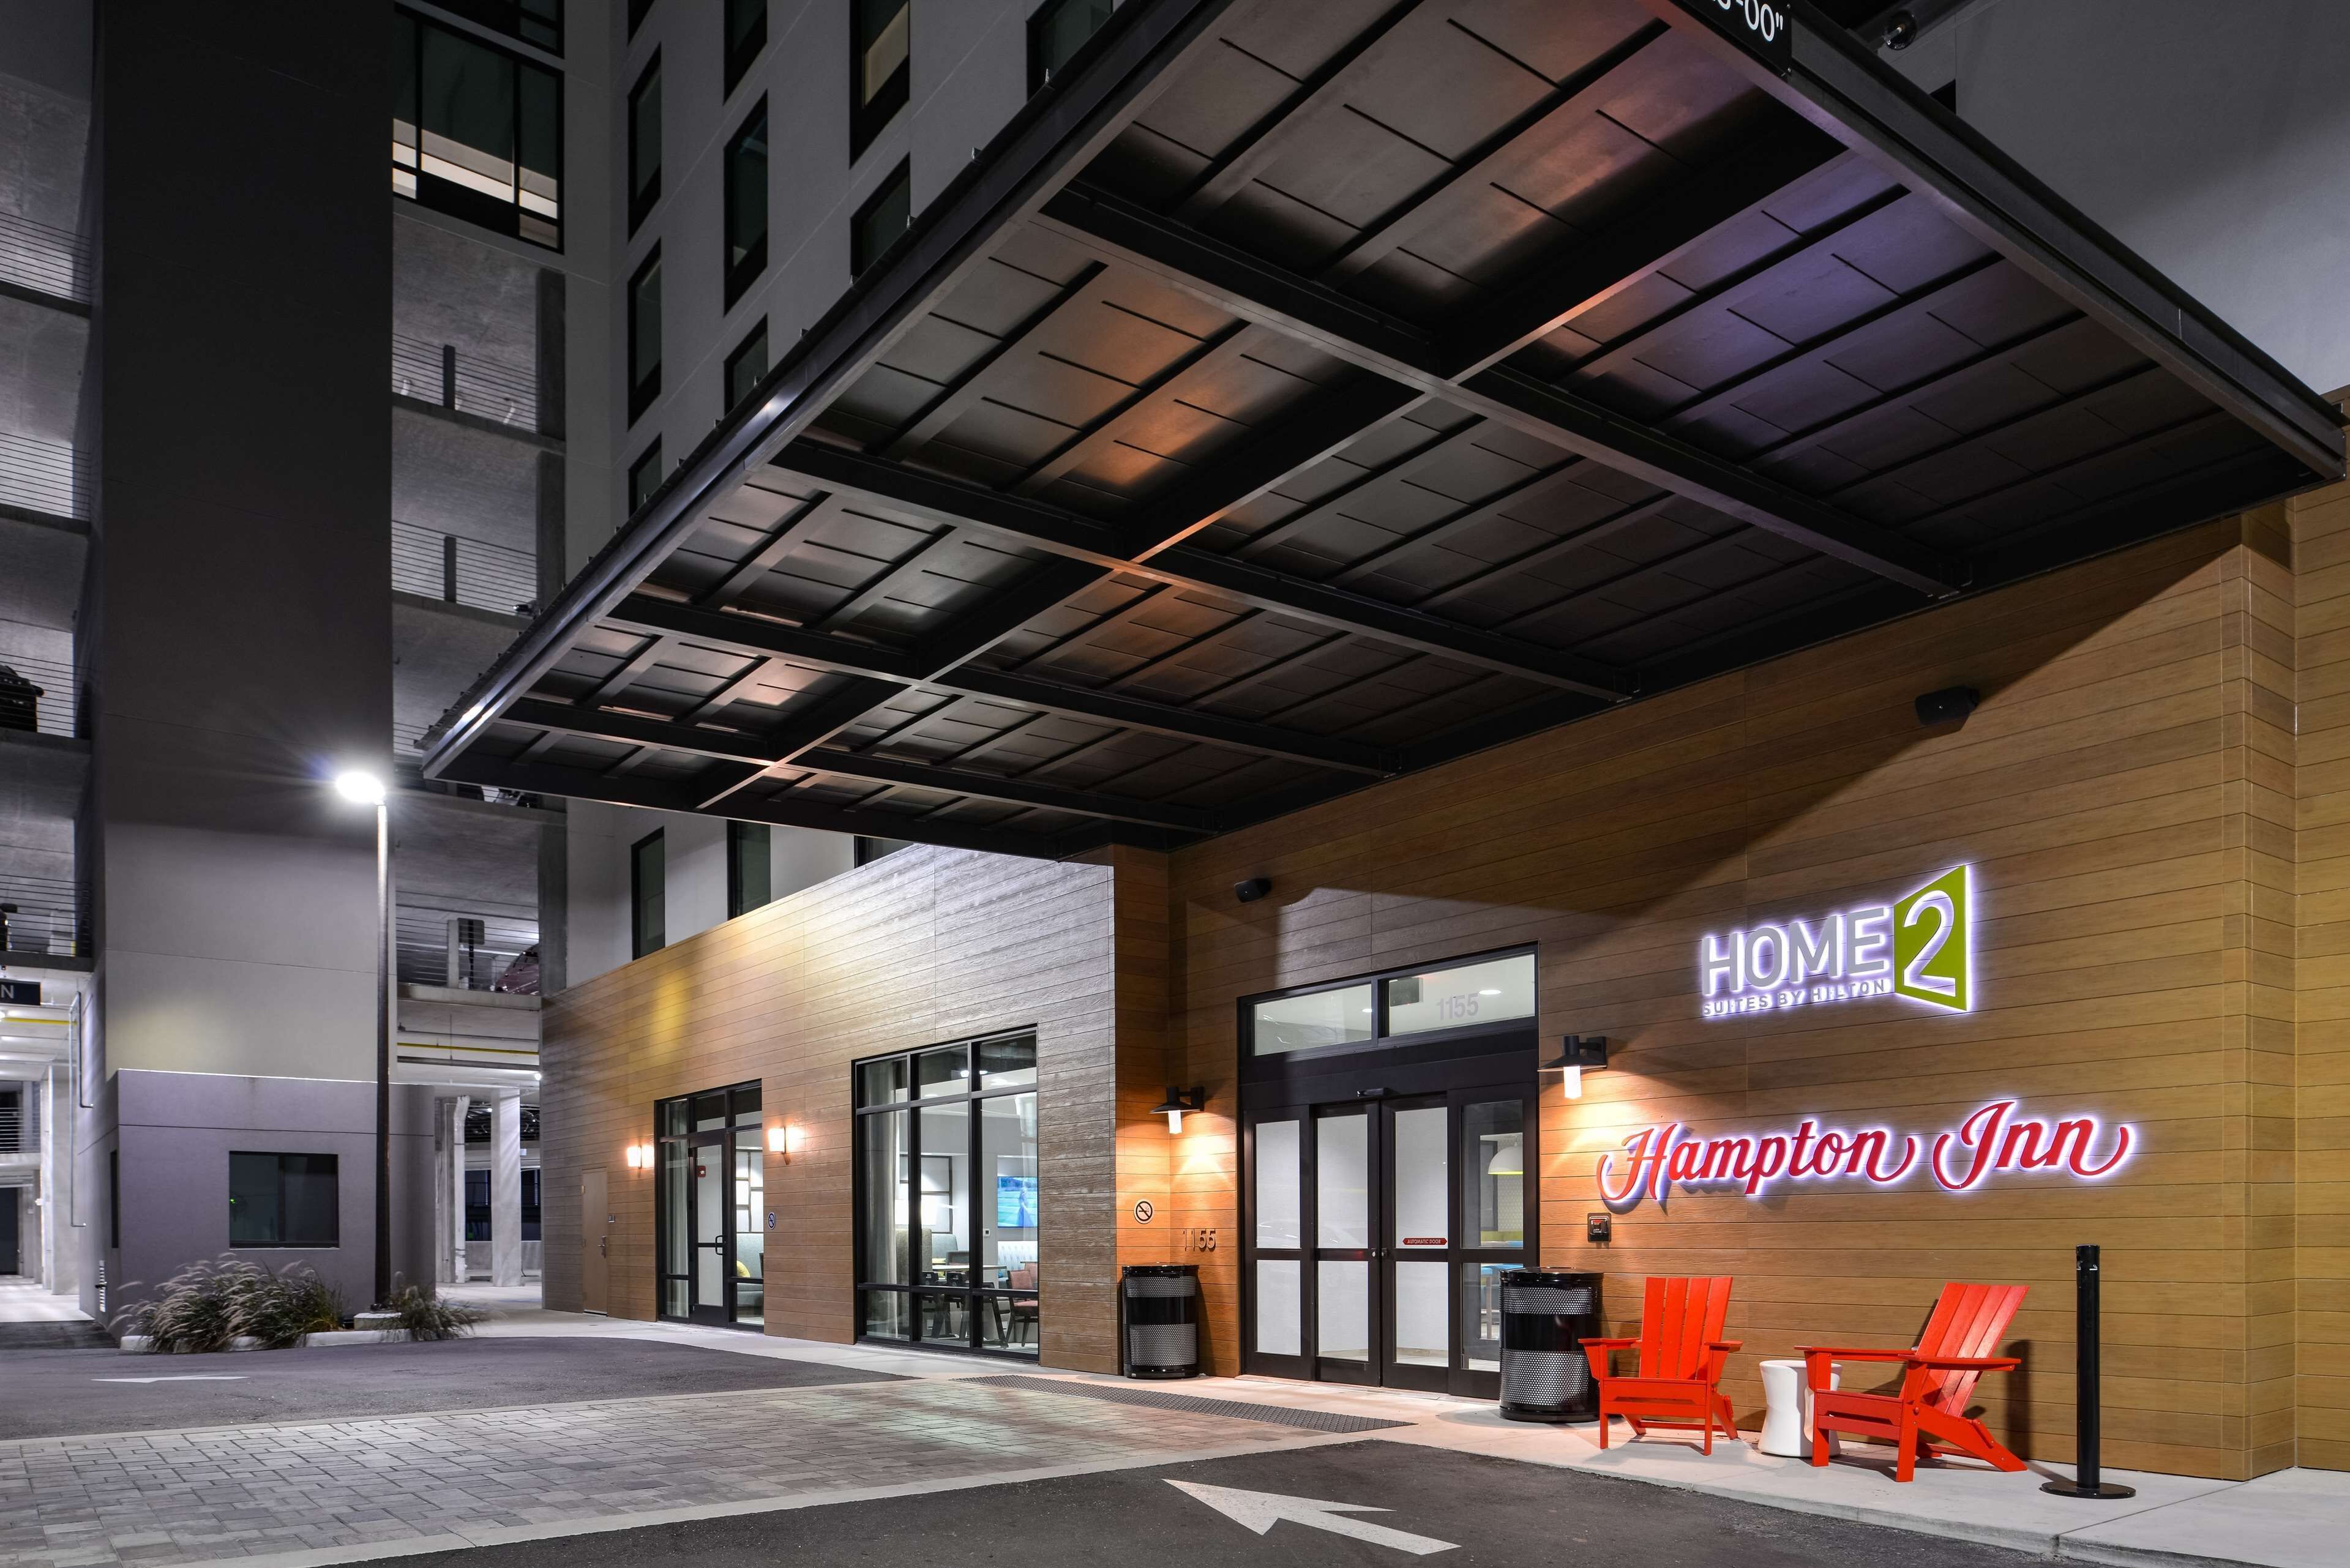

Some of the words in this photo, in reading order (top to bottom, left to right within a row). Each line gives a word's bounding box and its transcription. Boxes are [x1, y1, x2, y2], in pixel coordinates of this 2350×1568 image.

[1702, 907, 1885, 996] HOME
[1904, 890, 1955, 998] 2
[1435, 993, 1479, 1020] 1155
[1704, 995, 1769, 1016] SUITES
[1777, 990, 1803, 1006] BY
[1811, 979, 1885, 1002] HILTON
[1595, 1118, 1915, 1201] Hampton
[1933, 1100, 2130, 1190] Inn
[1183, 1228, 1216, 1252] 1155
